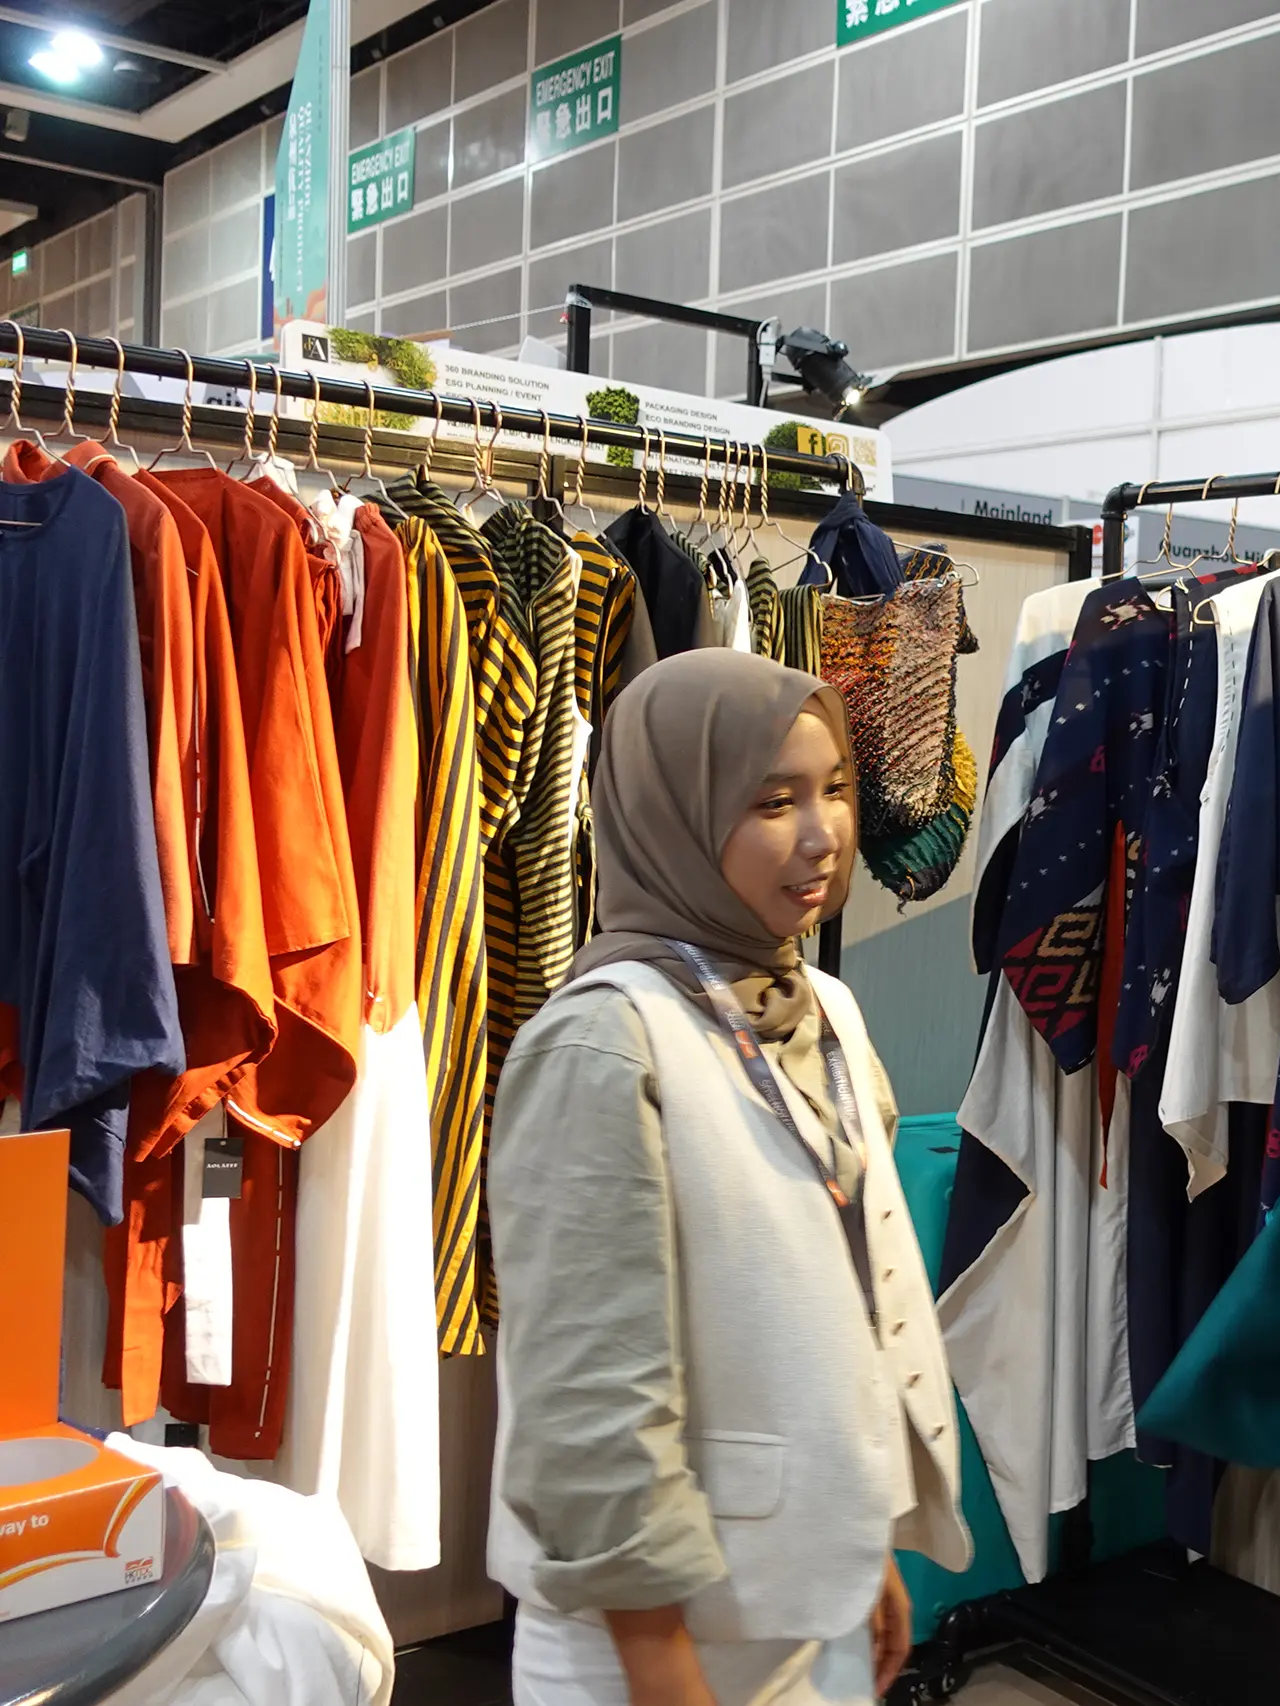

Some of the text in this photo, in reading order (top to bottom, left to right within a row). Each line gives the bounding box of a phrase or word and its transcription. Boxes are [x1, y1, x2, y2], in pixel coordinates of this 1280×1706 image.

[536, 50, 616, 107] EMERGENCY EXIT
[351, 140, 411, 186] EMERGENCY EXIT
[351, 170, 409, 222] 緊急出口
[445, 364, 550, 391] 360 BRANDING SOLUTION
[445, 378, 464, 389] ESG
[465, 382, 509, 396] PLANNING
[515, 390, 543, 402] EVENT
[645, 401, 718, 421] PACKAGING DESIGN
[645, 414, 731, 436] ECO BRANDING DESIGN
[974, 500, 1052, 525] Mainland
[1159, 539, 1240, 564] Quanzhou
[31, 1514, 50, 1529] to
